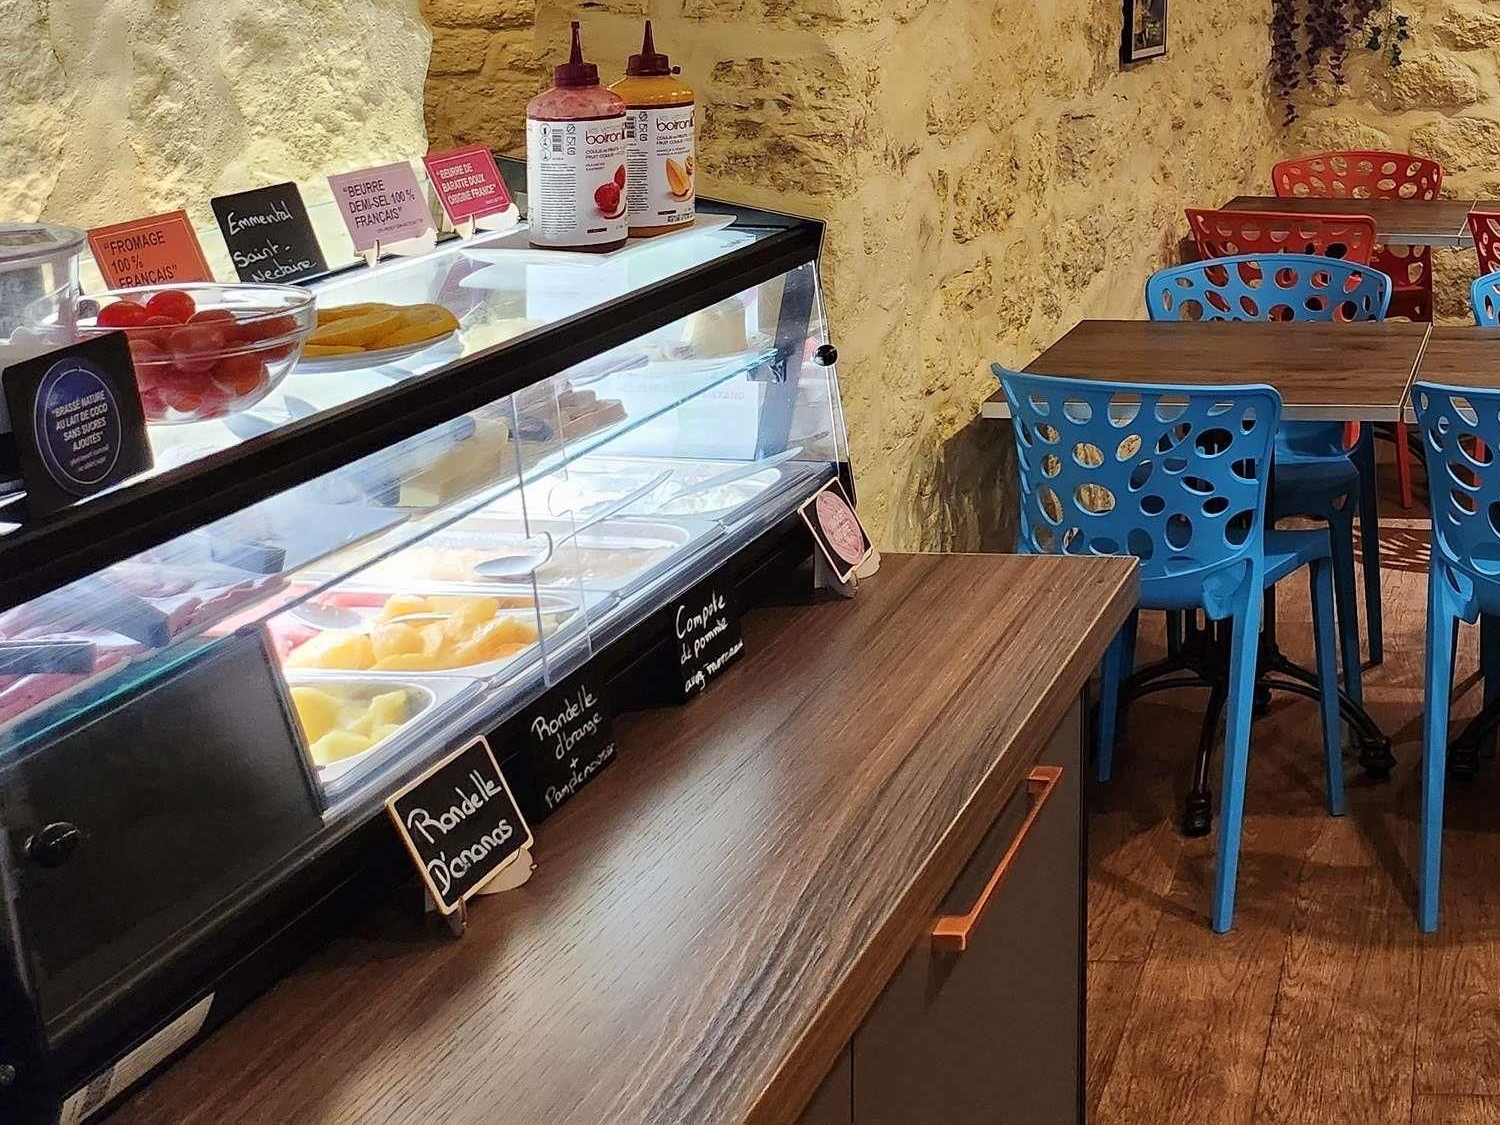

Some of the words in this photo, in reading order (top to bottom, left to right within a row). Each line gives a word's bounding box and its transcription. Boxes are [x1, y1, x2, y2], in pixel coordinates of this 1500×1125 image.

[442, 177, 469, 193] BARATTE
[349, 194, 391, 214] DEMI-SEL
[391, 190, 406, 204] 100
[227, 200, 294, 235] Emmental
[111, 257, 131, 274] 100
[251, 258, 318, 283] Nectaire
[66, 411, 80, 428] LAIT
[89, 402, 109, 418] COCO
[63, 424, 81, 442] SANS
[676, 588, 726, 639] Compote
[530, 683, 598, 742] Rondelle
[406, 769, 503, 845] Rondelle
[426, 818, 514, 897] D'ananas
